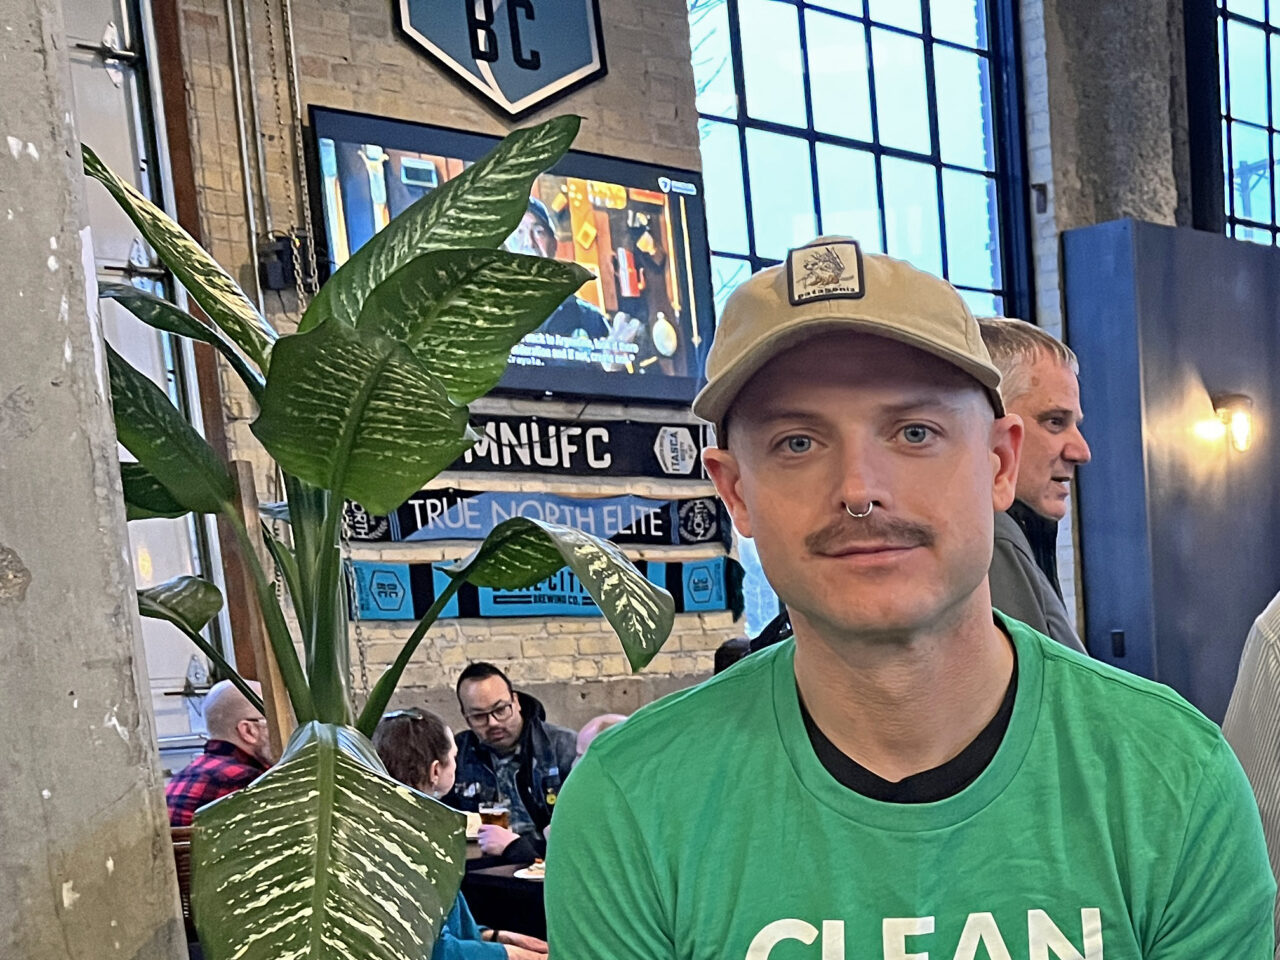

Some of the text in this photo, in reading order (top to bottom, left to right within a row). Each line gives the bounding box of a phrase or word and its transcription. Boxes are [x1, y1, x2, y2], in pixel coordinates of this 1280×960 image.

[463, 422, 611, 469] MNUFC
[351, 500, 369, 539] ORTH
[408, 497, 482, 530] TRUE
[603, 505, 663, 537] ELITE
